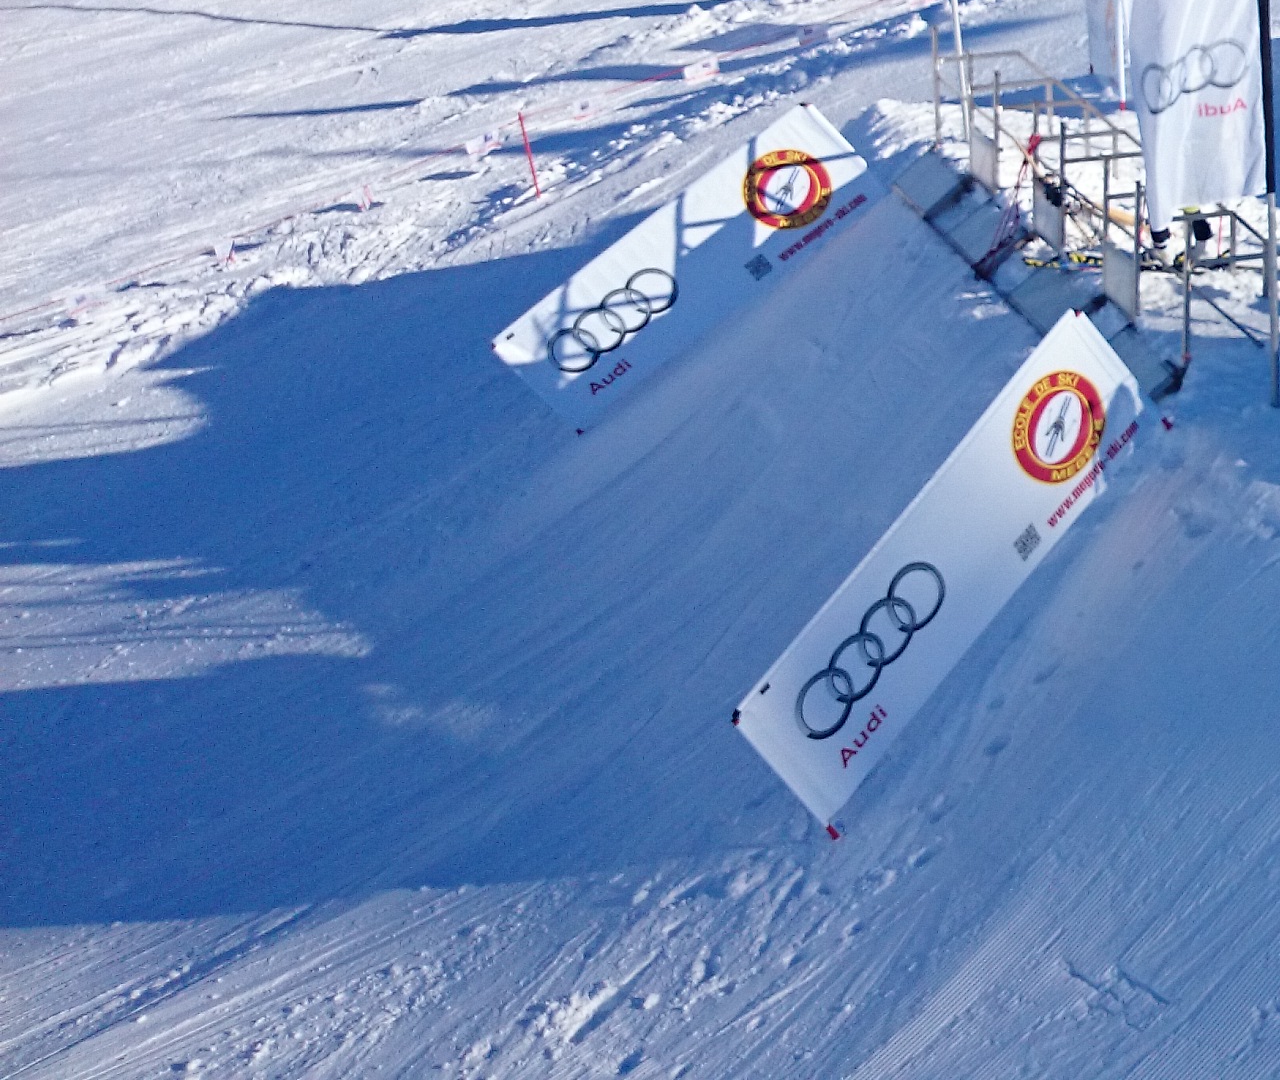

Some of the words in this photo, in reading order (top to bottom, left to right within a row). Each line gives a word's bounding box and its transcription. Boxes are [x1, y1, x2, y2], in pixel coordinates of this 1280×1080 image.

[590, 358, 632, 395] Audi
[1014, 397, 1032, 451] ECOLE
[1035, 377, 1050, 396] DE
[1057, 371, 1079, 388] SKI
[841, 704, 888, 768] Audi
